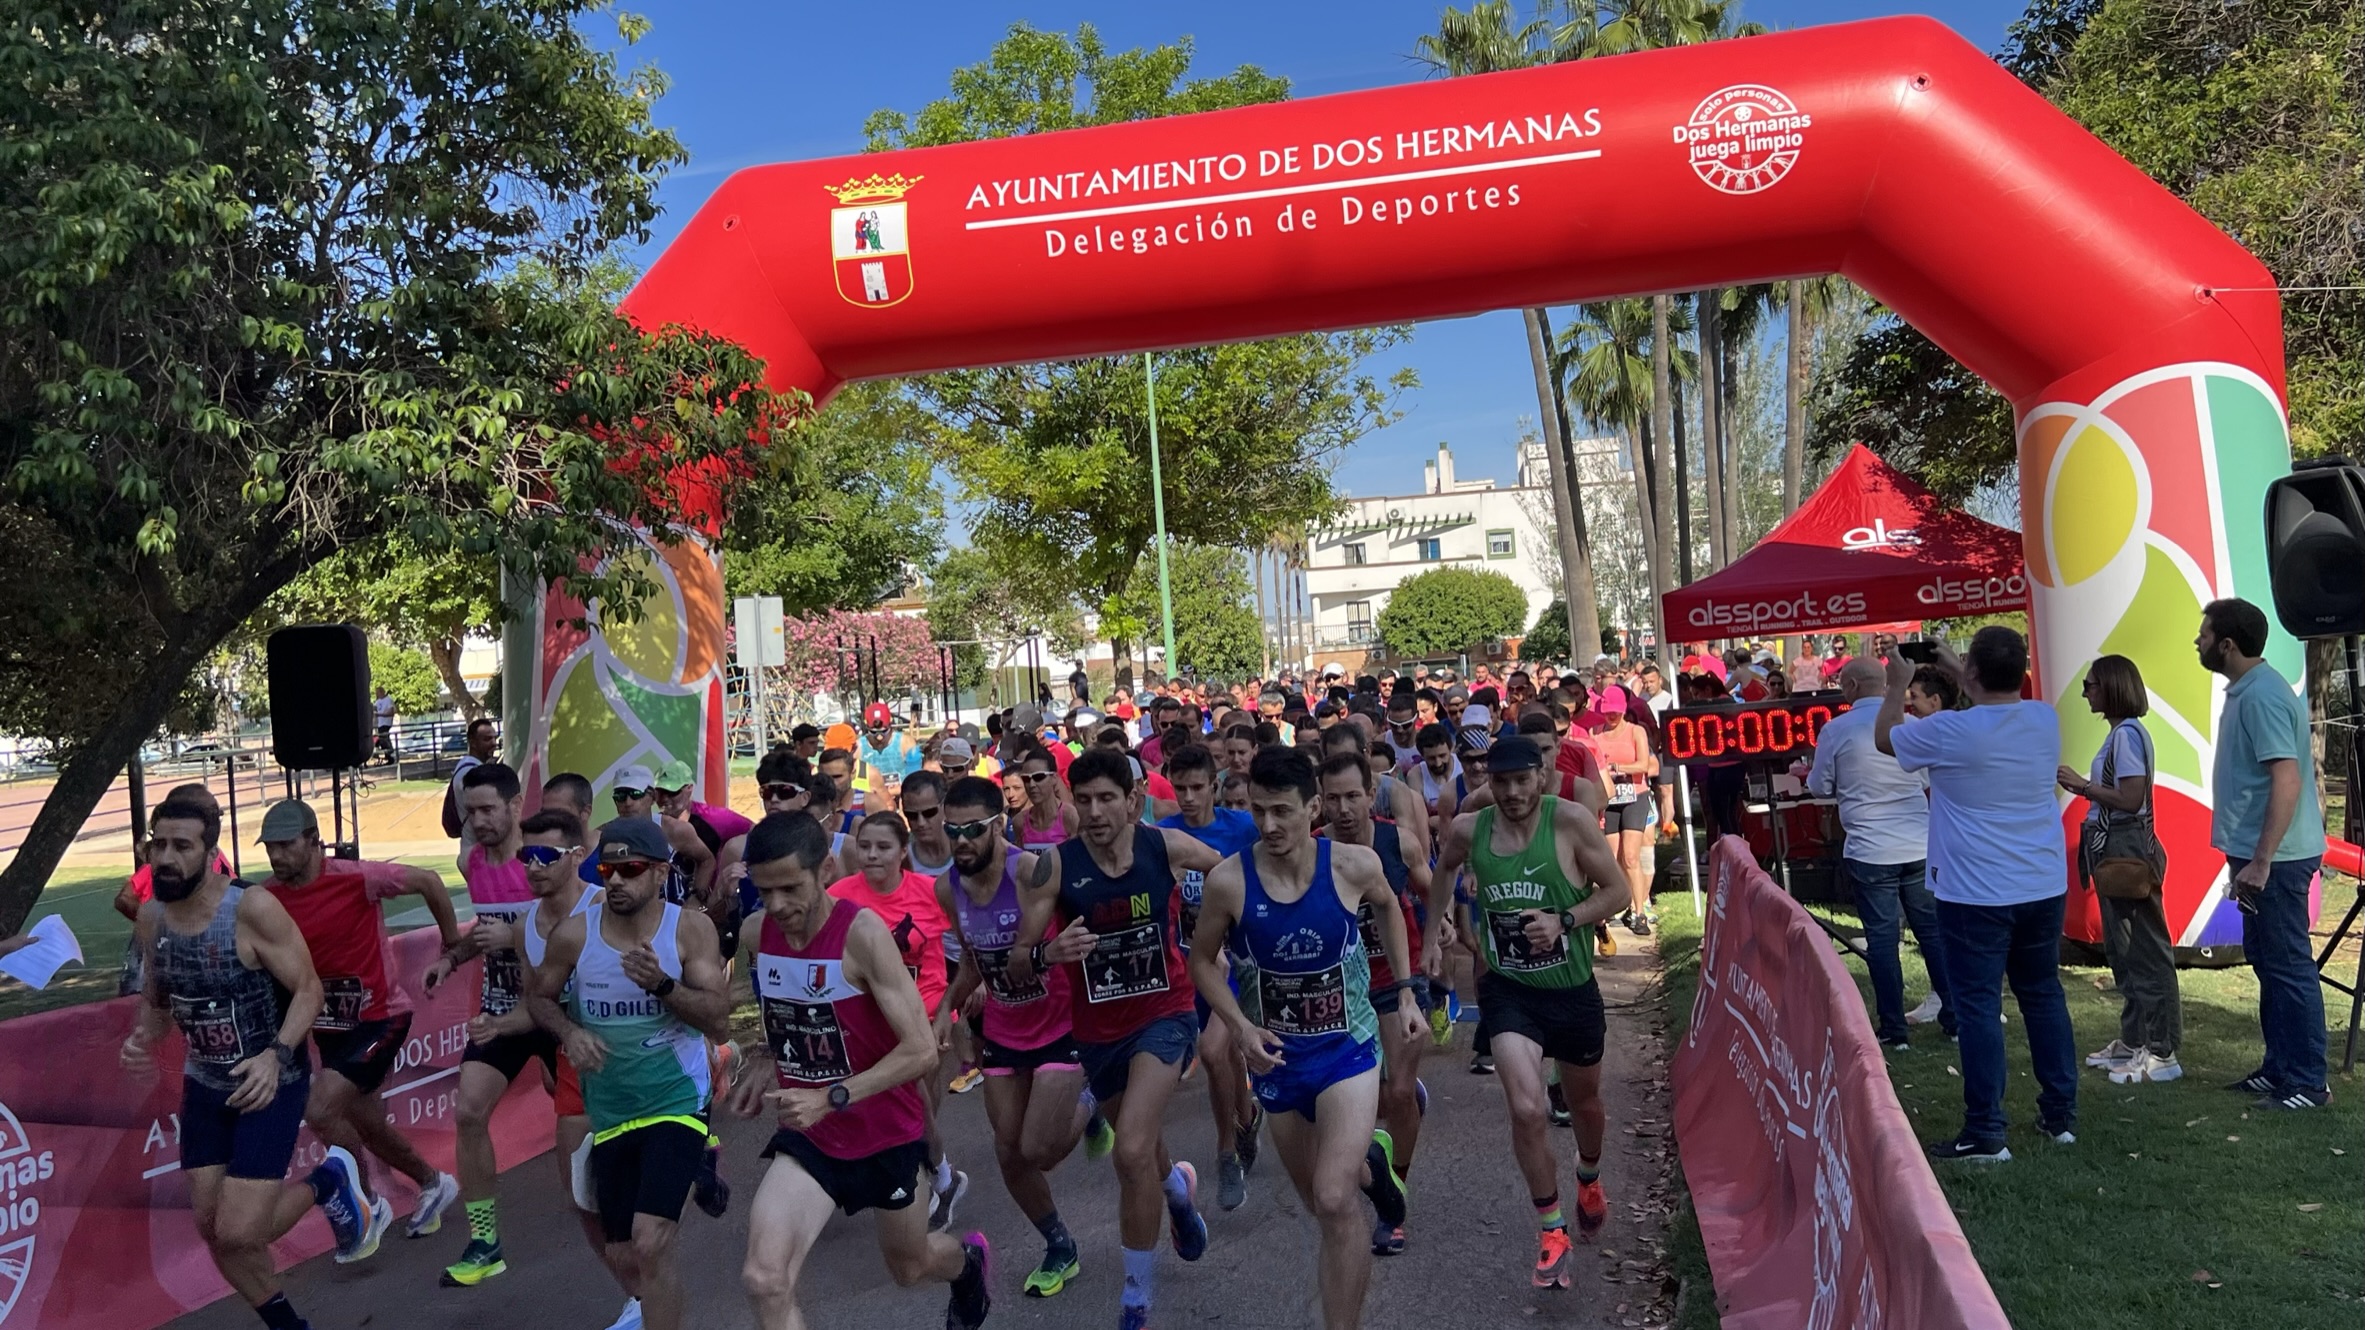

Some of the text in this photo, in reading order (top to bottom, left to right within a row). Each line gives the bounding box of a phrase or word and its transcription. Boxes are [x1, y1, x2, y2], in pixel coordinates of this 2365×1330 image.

[1724, 88, 1785, 112] personas
[1672, 114, 1812, 144] Dos Hermanas
[965, 108, 1602, 210] AYUNTAMIENTO DE DOS HERMANAS
[1688, 130, 1804, 163] juega limpio
[1045, 184, 1522, 258] Delegación de Deportes
[1688, 590, 1867, 632] alssport.es
[1956, 601, 1986, 611] TIENDA
[1725, 614, 1868, 634] TIENDA RUNNING TRAIL OUTDOOR
[1122, 944, 1161, 958] MASCULINO
[1128, 951, 1154, 977] 17
[1302, 985, 1343, 998] MASCULINO
[337, 996, 357, 1018] 47
[1300, 991, 1343, 1020] 139
[194, 1023, 236, 1048] 158
[803, 1033, 835, 1062] 14
[394, 1034, 433, 1074] DOS
